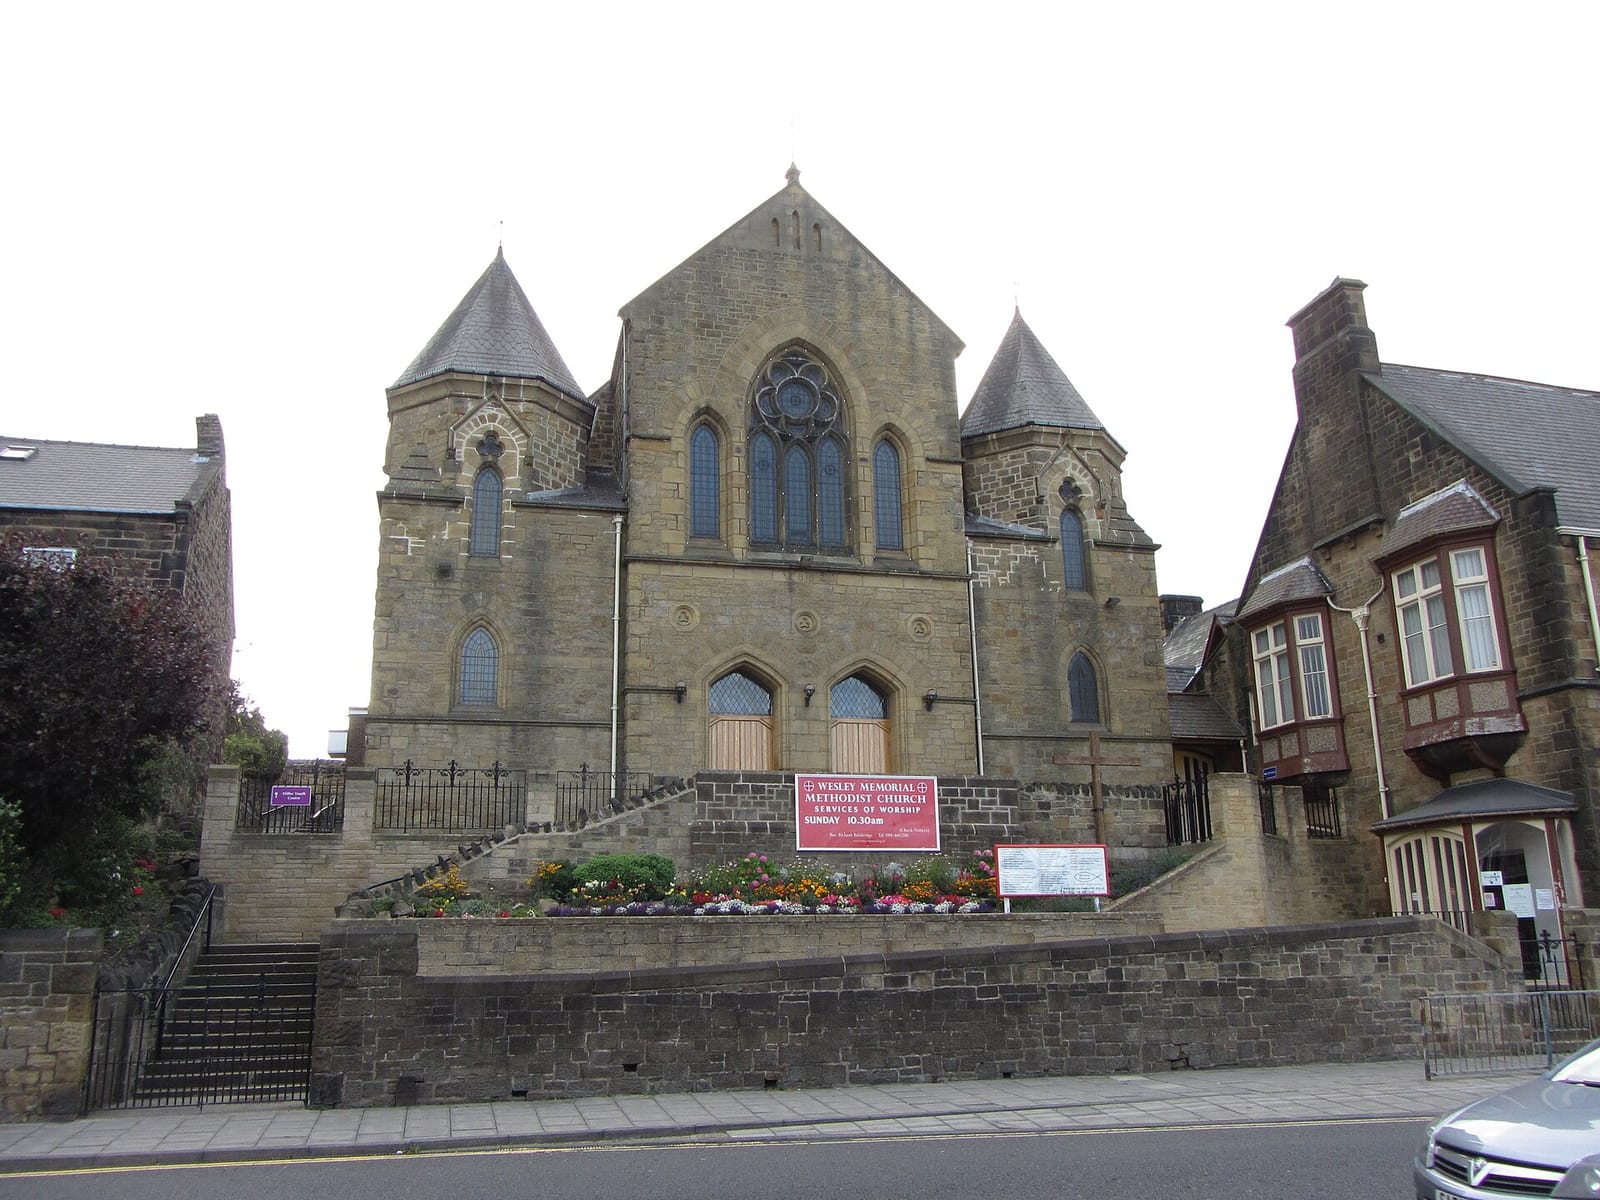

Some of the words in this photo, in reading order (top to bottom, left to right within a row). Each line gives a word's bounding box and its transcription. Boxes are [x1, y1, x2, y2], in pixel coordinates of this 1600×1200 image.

[818, 782, 856, 791] WESLEY
[860, 782, 915, 792] MEMORIAL
[805, 793, 872, 803] METHODIST
[877, 794, 926, 803] CHURCH
[814, 805, 858, 813] SERVICES
[863, 806, 875, 814] OF
[880, 806, 921, 814] WORSHIP
[804, 816, 840, 824] SUNDAY
[847, 816, 884, 825] 10.30am
